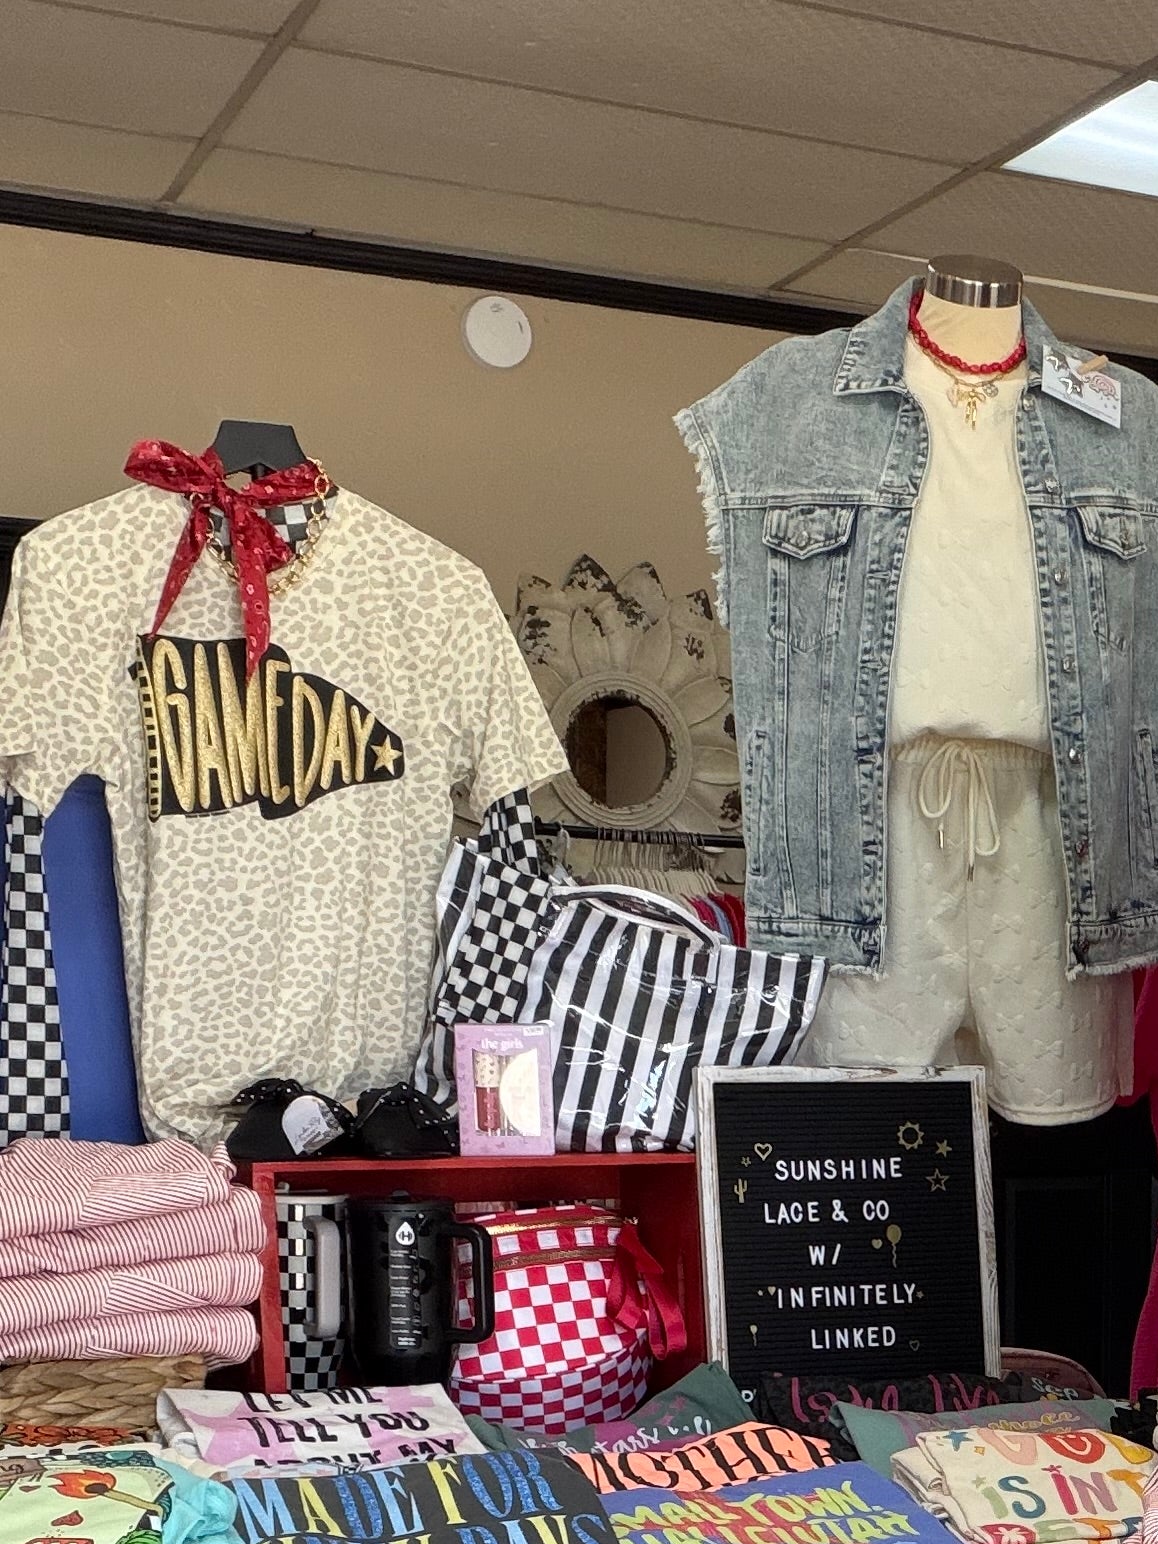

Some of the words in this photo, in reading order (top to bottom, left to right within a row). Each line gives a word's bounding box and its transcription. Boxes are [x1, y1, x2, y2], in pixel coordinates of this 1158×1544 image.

[481, 1037, 498, 1050] the
[774, 1156, 904, 1181] SUNSHINE
[763, 1201, 821, 1225] LACE
[831, 1198, 849, 1223] &
[862, 1199, 890, 1222] CO
[808, 1243, 842, 1266] W/
[777, 1283, 917, 1309] INFINITELY
[810, 1325, 896, 1350] LINKED
[236, 1416, 338, 1448] TELL
[336, 1411, 430, 1439] YOU
[426, 1448, 565, 1525] FOR
